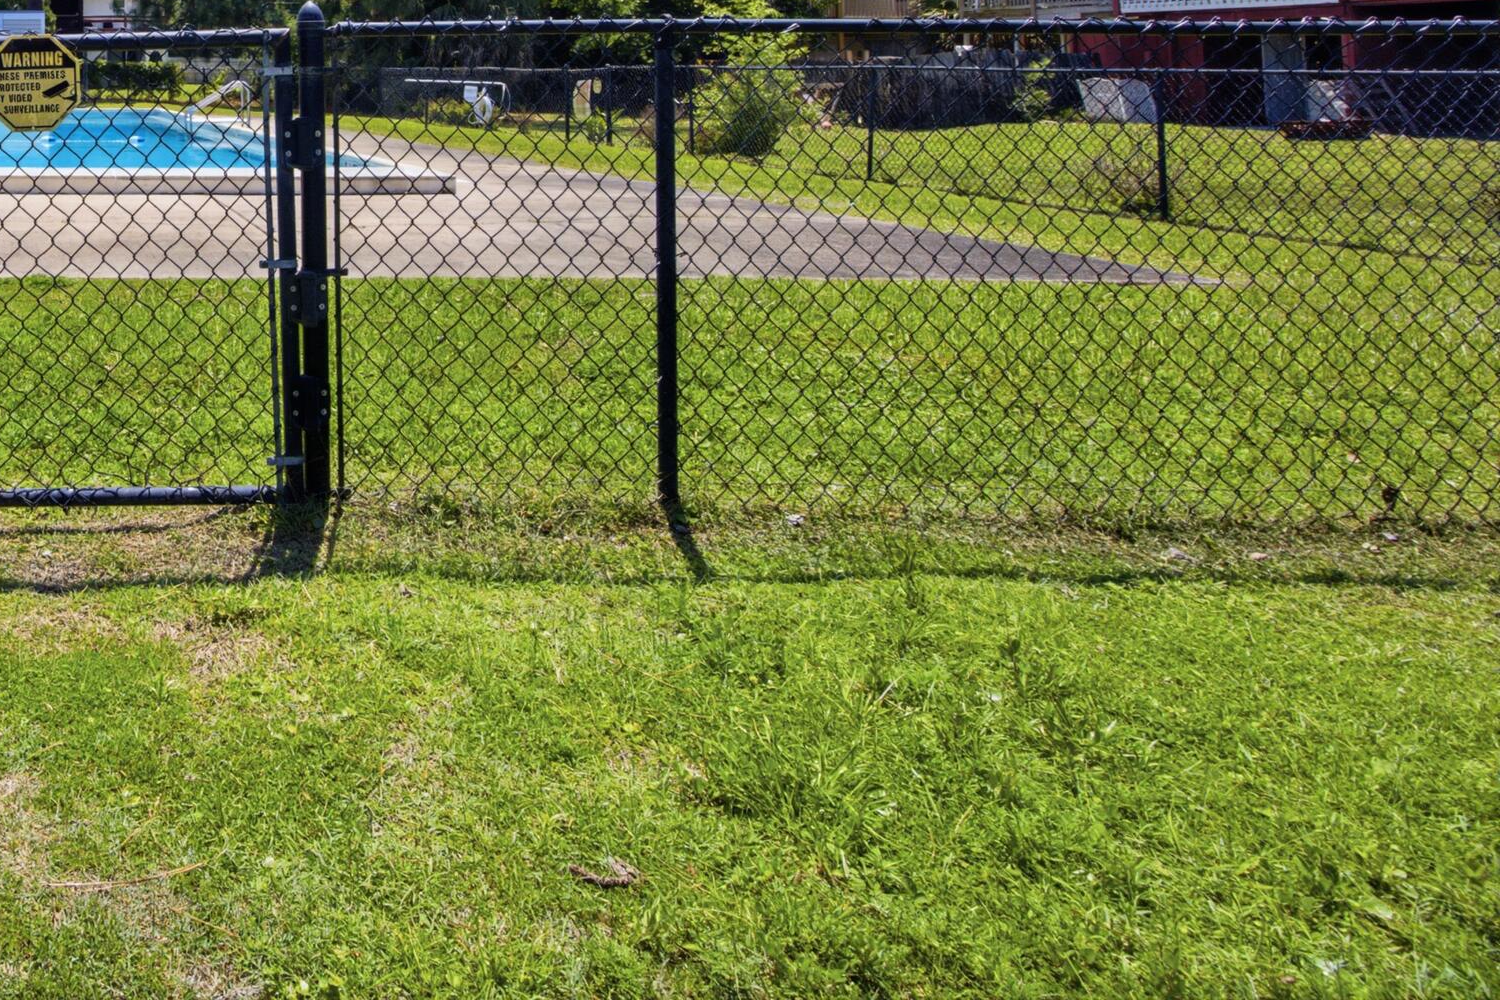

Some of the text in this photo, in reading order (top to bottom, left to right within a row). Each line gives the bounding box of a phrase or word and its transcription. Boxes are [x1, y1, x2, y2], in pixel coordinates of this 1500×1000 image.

[1, 50, 63, 68] WARNING
[23, 70, 66, 80] PREMISES
[8, 93, 33, 102] VIDEO
[3, 104, 60, 114] SURVEILLANCE
